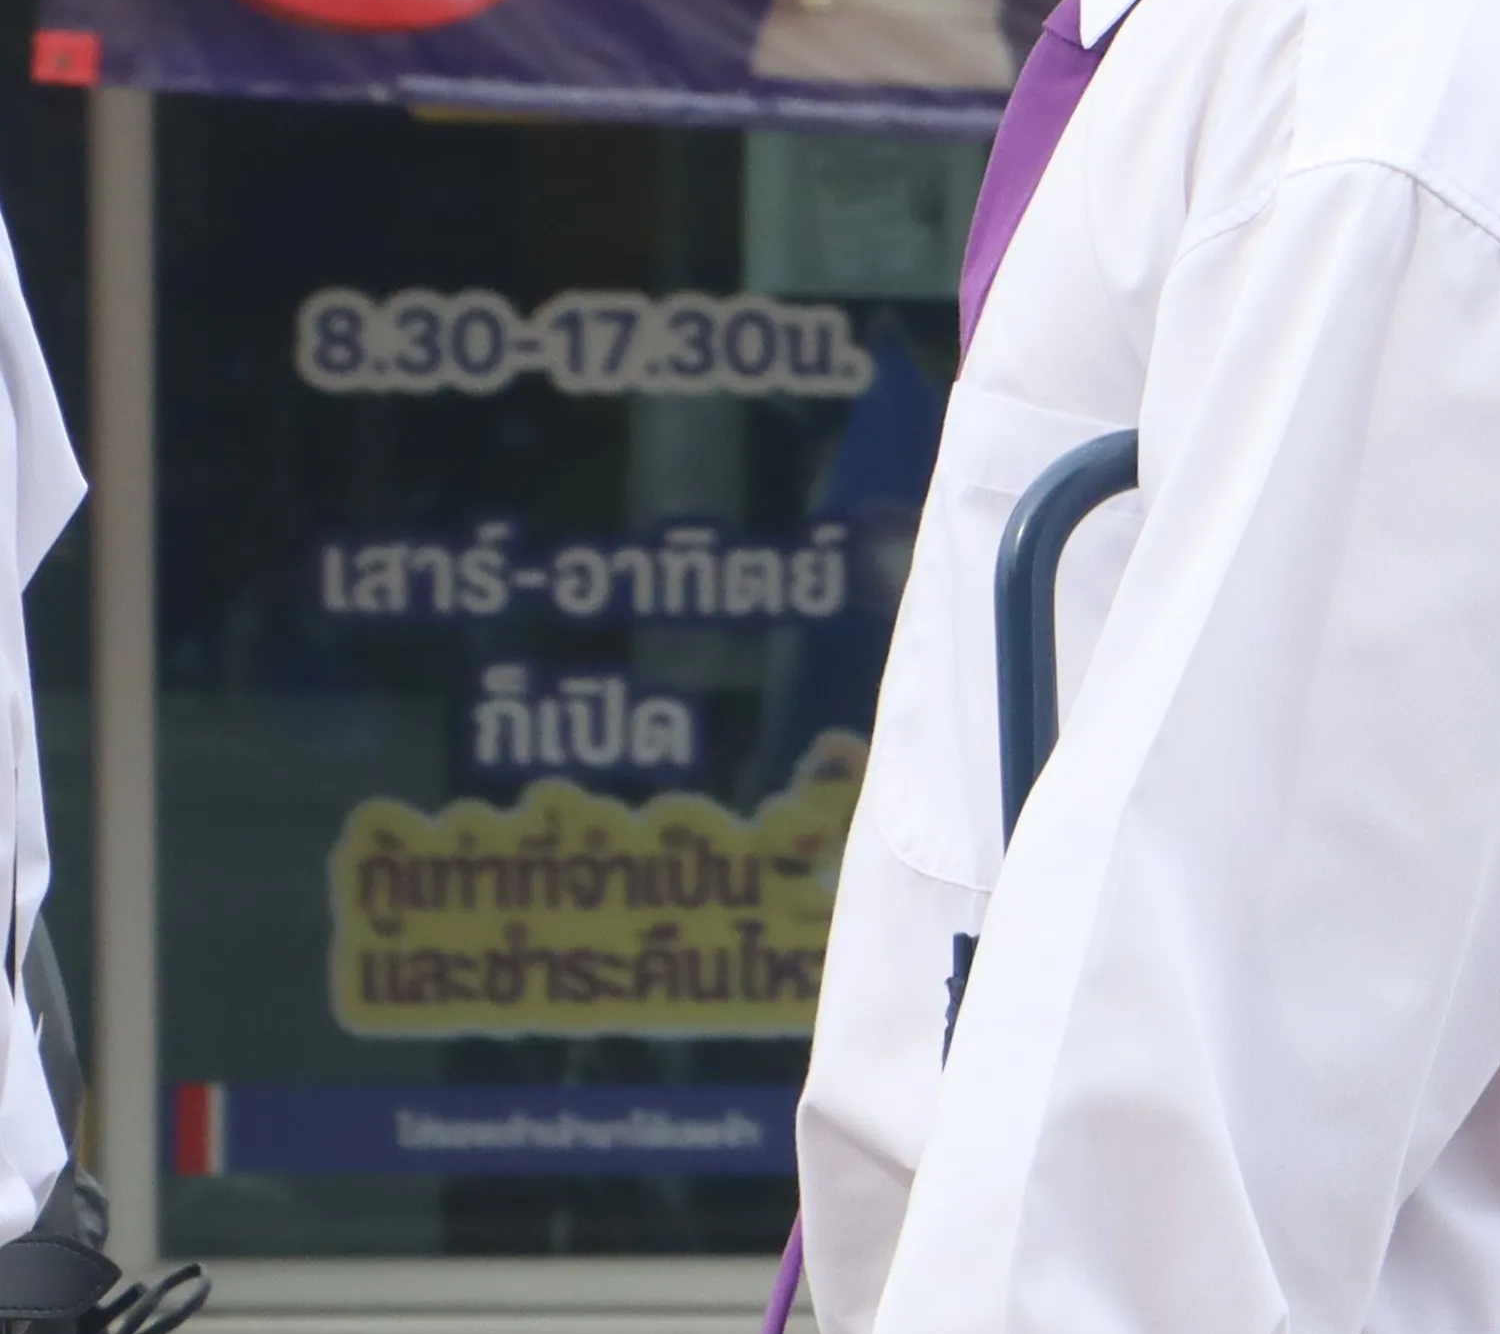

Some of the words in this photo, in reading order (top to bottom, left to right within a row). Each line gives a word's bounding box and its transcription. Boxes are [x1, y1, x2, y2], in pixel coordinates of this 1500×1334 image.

[306, 299, 864, 385] 8.30-17.30น.
[320, 522, 848, 618] เสาร์-อาทิตย์
[472, 664, 694, 766] ก็เปิด
